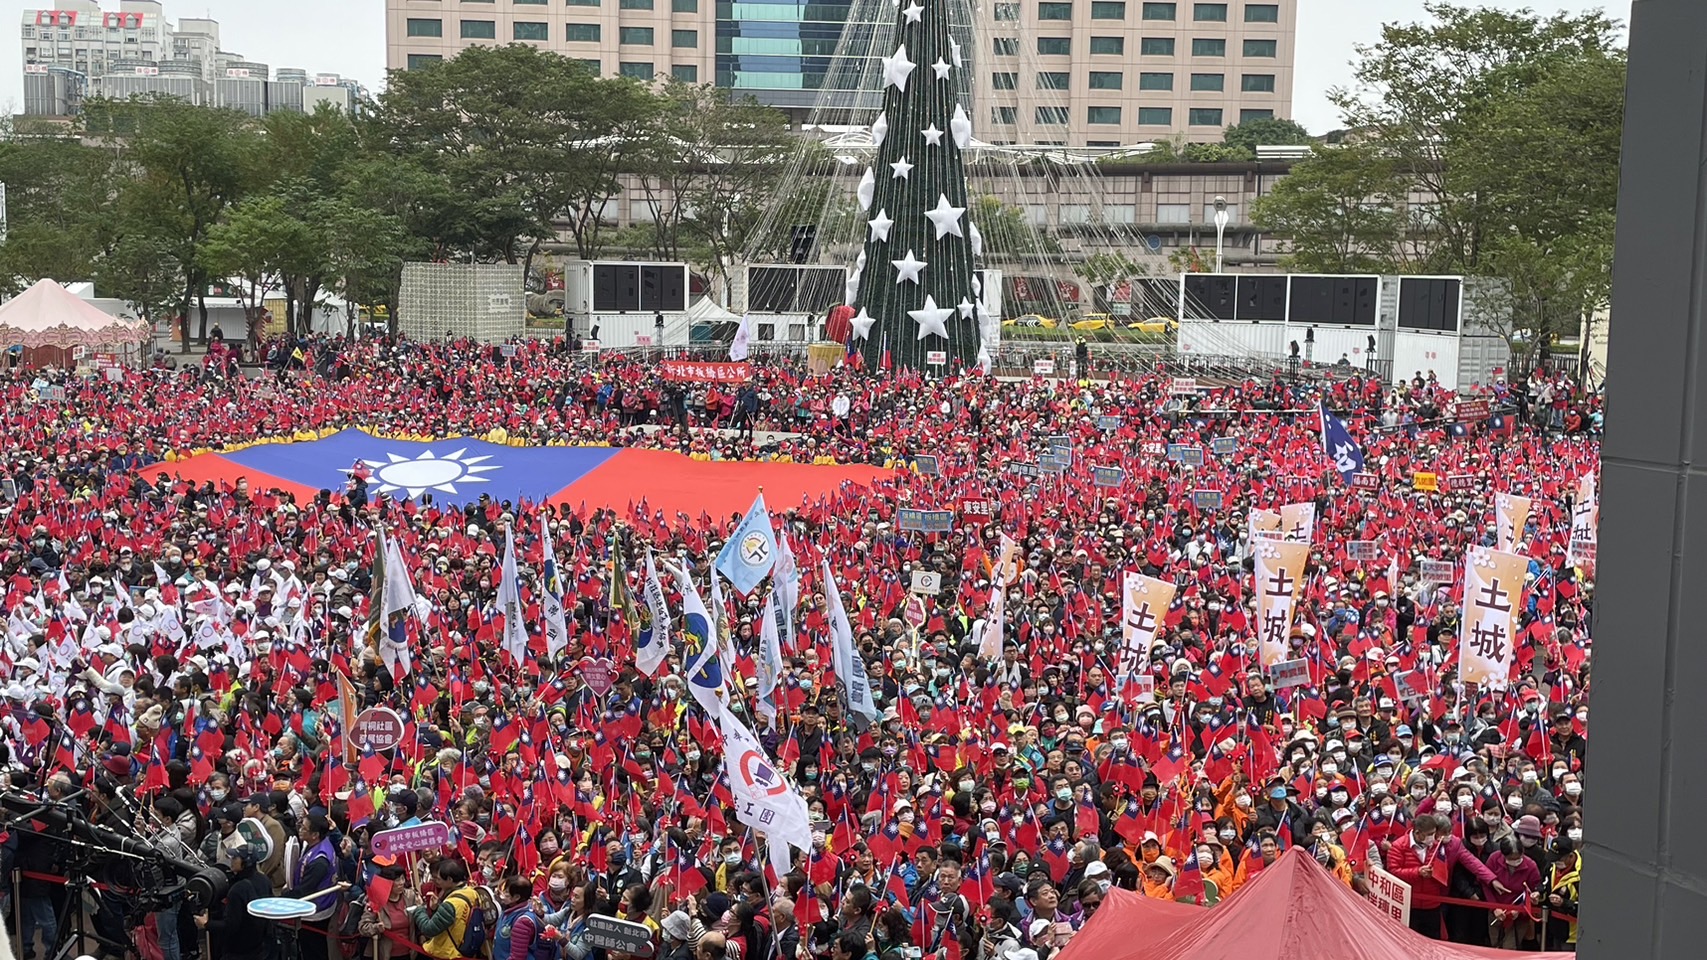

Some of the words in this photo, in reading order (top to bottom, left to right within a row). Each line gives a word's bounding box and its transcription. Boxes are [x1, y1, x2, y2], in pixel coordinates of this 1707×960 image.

[666, 363, 746, 379] 新北市板橋區公所
[963, 500, 988, 515] 東安里
[1265, 568, 1294, 644] 土城
[1469, 578, 1512, 663] 土城
[1121, 602, 1157, 674] 土城
[1368, 869, 1405, 906] 中和區
[584, 932, 637, 953] 中醫師公會
[589, 919, 622, 934] 社團法人
[624, 926, 649, 939] 新北市
